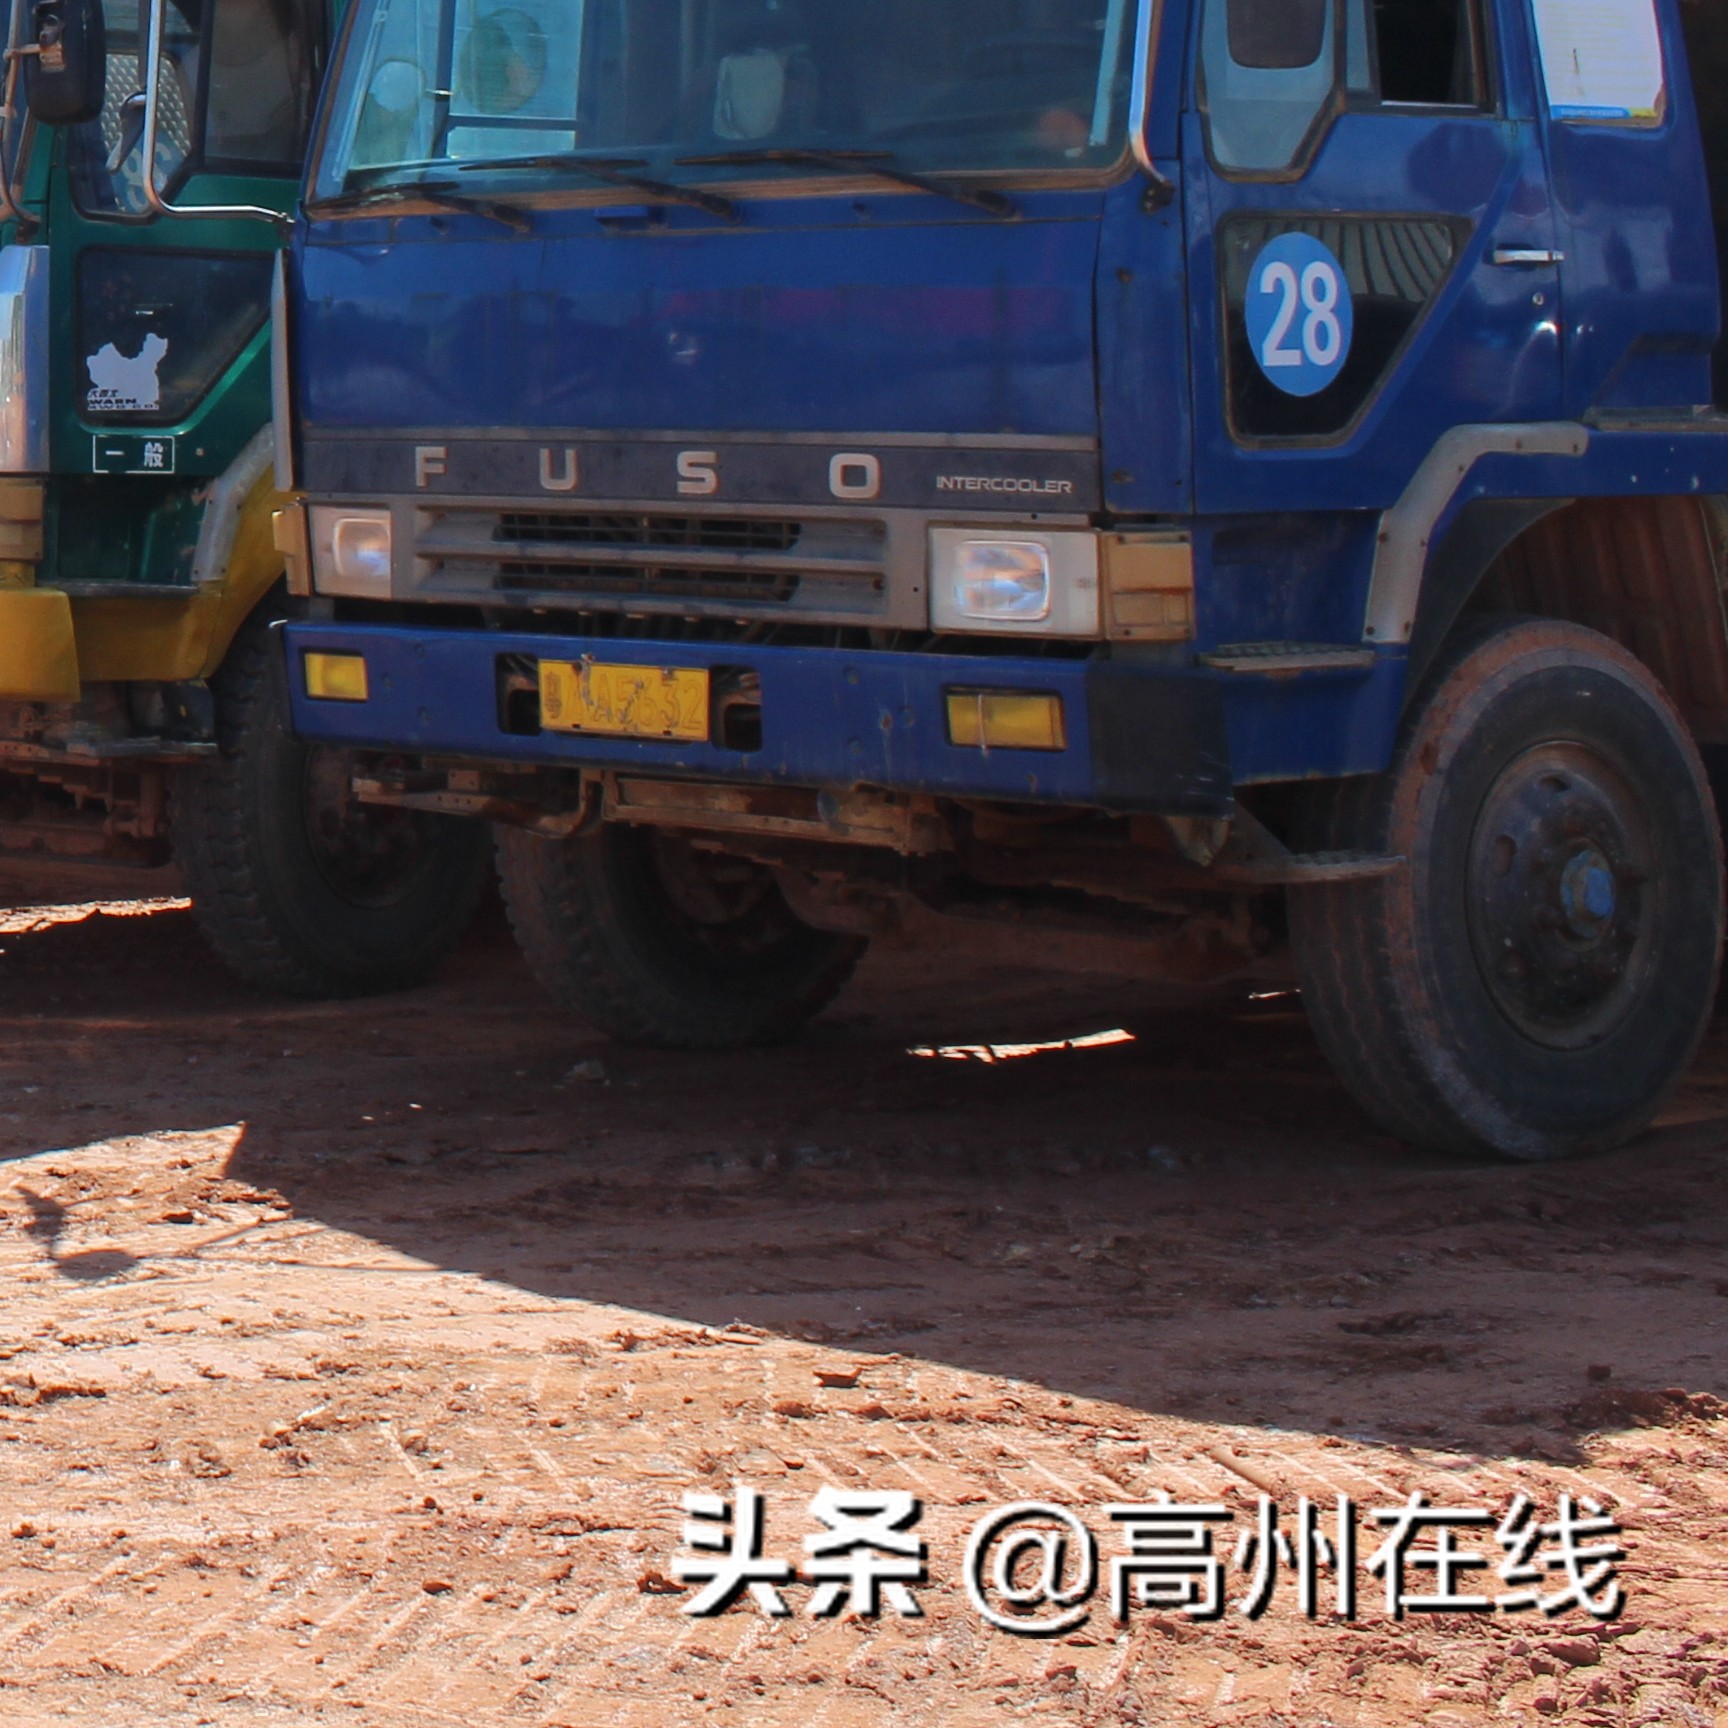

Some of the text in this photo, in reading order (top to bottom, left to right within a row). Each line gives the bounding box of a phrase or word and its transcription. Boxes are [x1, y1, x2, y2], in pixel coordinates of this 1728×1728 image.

[1259, 260, 1342, 367] 28
[105, 441, 164, 468] 一般
[414, 445, 1073, 500] FUSO INTERCOOLER
